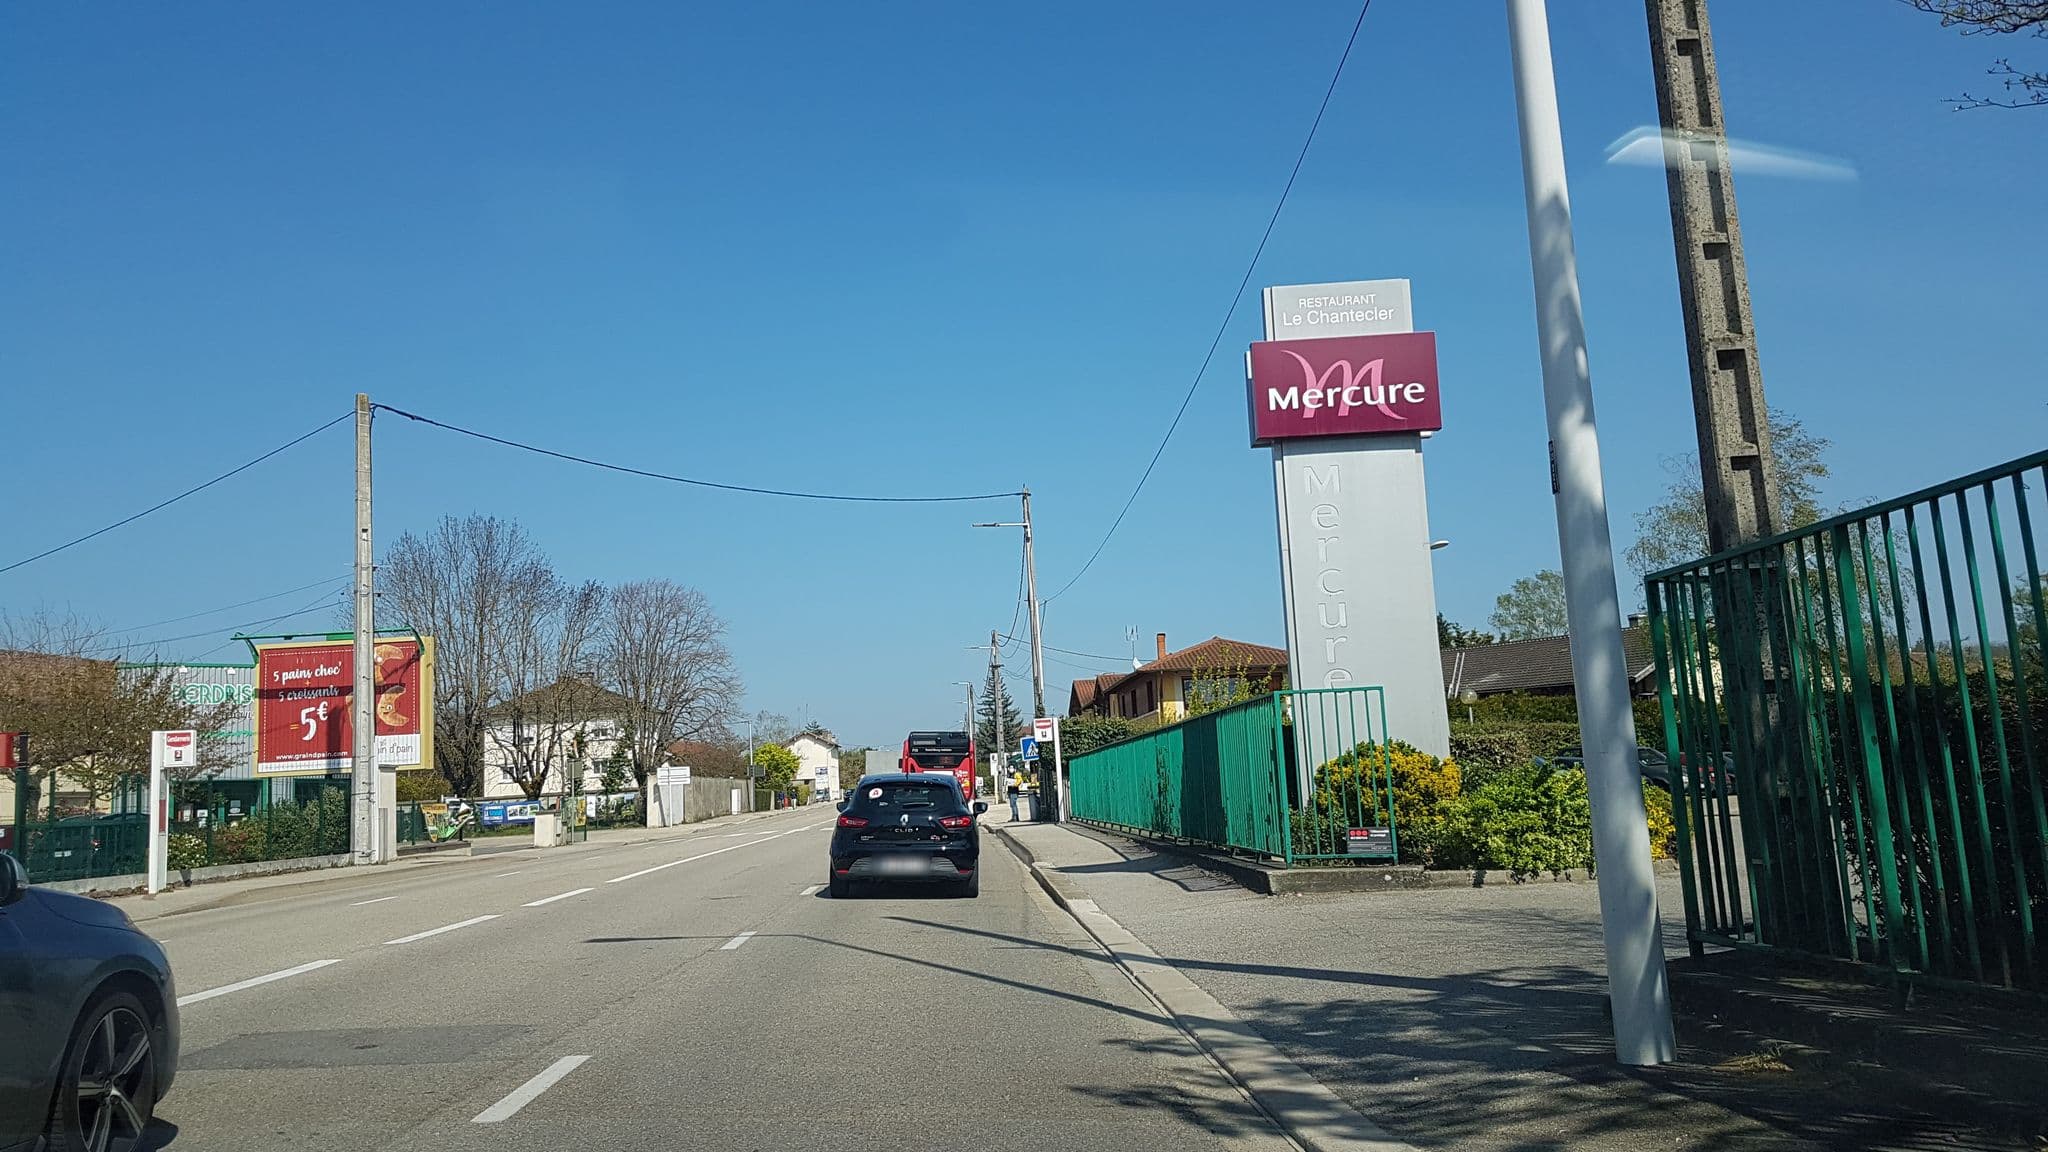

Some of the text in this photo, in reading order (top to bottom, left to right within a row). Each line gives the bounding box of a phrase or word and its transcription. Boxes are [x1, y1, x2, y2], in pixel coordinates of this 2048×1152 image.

[1299, 294, 1376, 309] RESTAURANT
[1283, 307, 1395, 326] Le Chantecler
[1267, 381, 1426, 411] Mercure
[273, 669, 280, 681] 5
[281, 664, 313, 686] pains
[171, 682, 254, 705] PERDRIS
[278, 685, 340, 702] 5 croissants
[276, 750, 349, 761] www.graindpain.com
